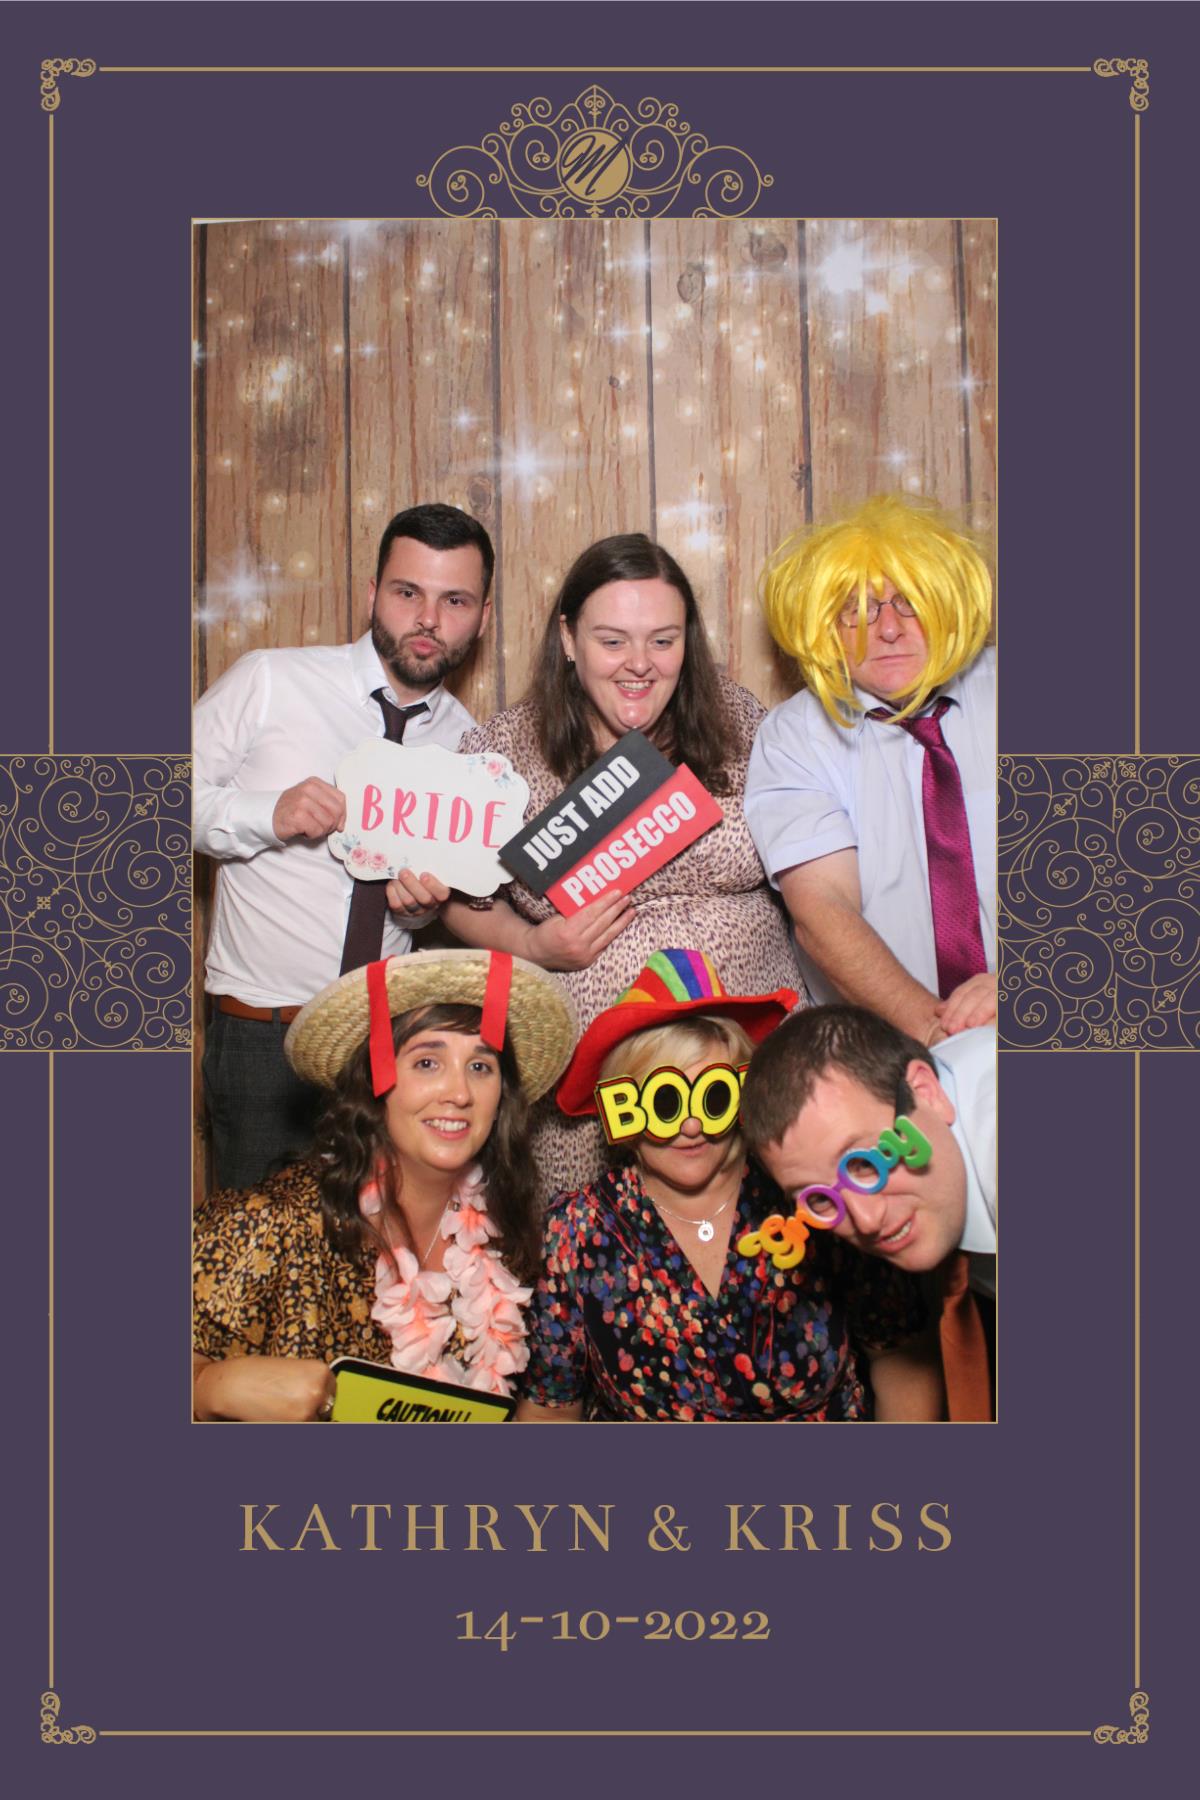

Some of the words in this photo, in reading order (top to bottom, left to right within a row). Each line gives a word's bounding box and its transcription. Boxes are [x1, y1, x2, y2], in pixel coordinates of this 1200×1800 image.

[361, 784, 507, 849] BRIDE
[522, 801, 590, 872] JUST
[578, 755, 641, 819] ADD
[560, 791, 697, 908] PROSECCO
[596, 1063, 750, 1145] BOO
